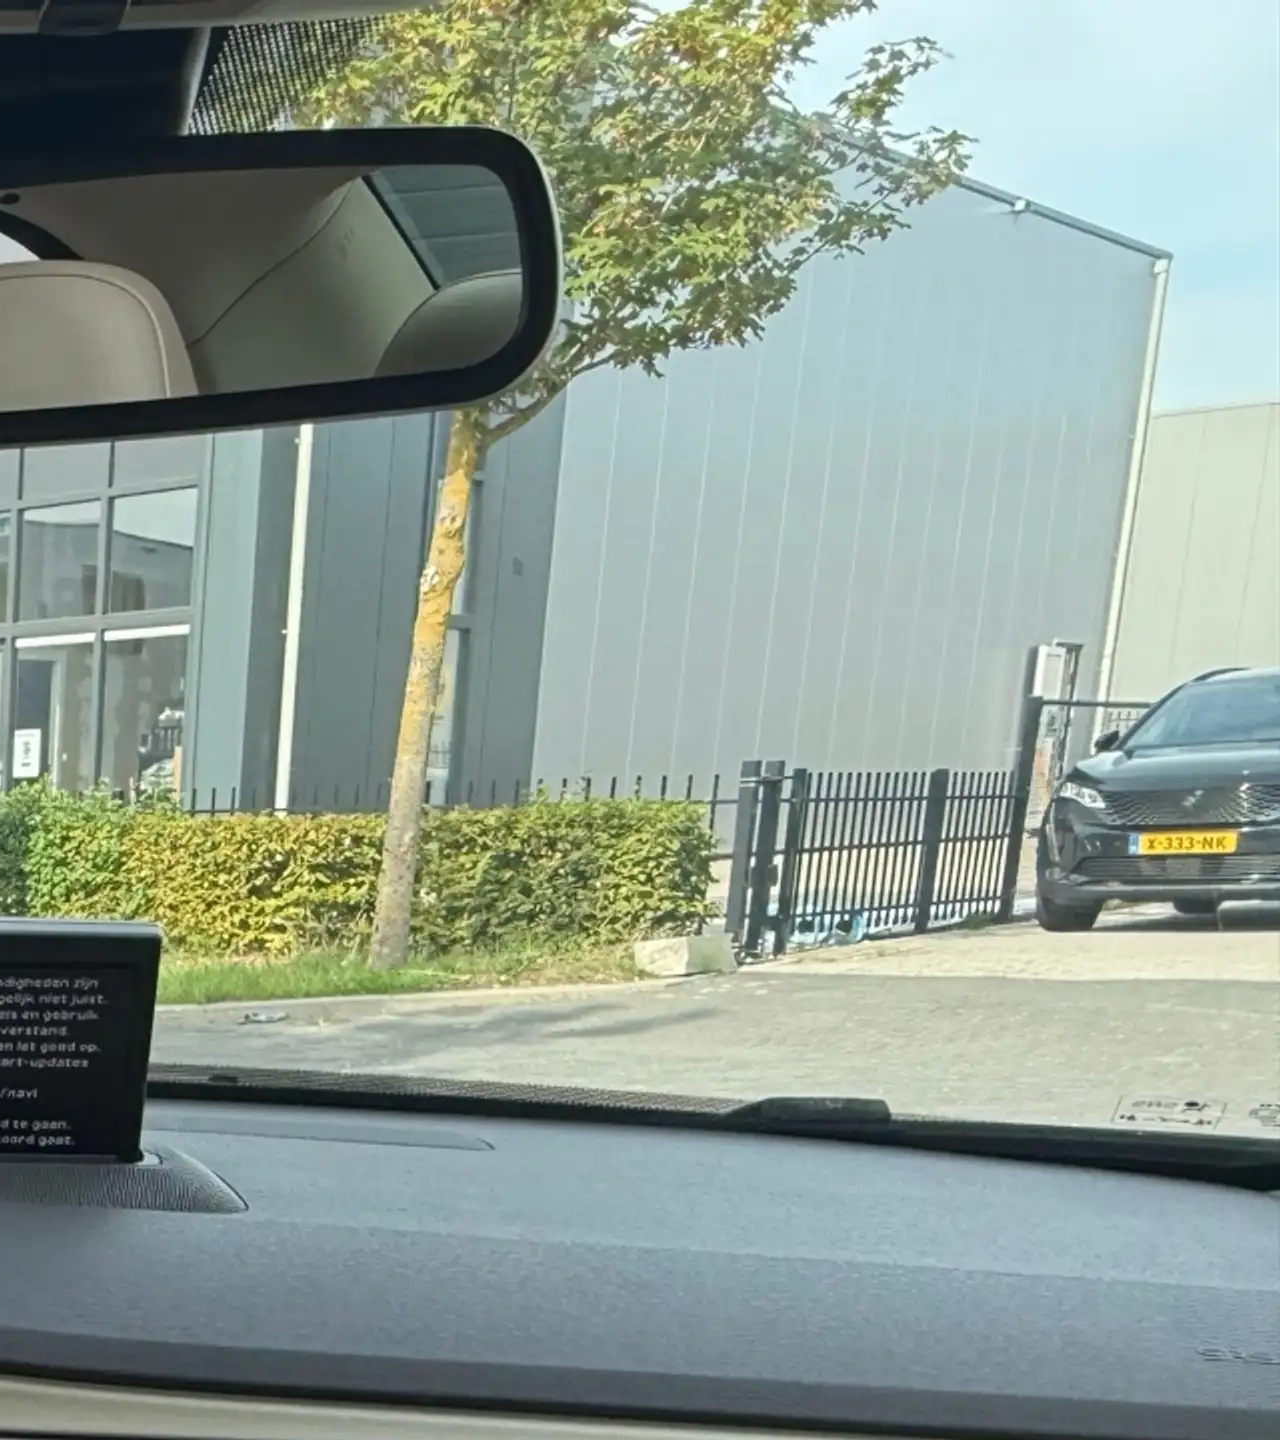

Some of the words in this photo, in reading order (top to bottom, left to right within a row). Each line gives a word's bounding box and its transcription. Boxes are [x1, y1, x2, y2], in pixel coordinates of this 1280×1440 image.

[73, 977, 99, 991] zijn
[38, 993, 68, 1005] niet
[21, 1010, 40, 1020] en
[42, 1009, 100, 1023] gebruik
[16, 1040, 37, 1052] let
[40, 1041, 77, 1054] goed
[12, 1118, 29, 1130] te
